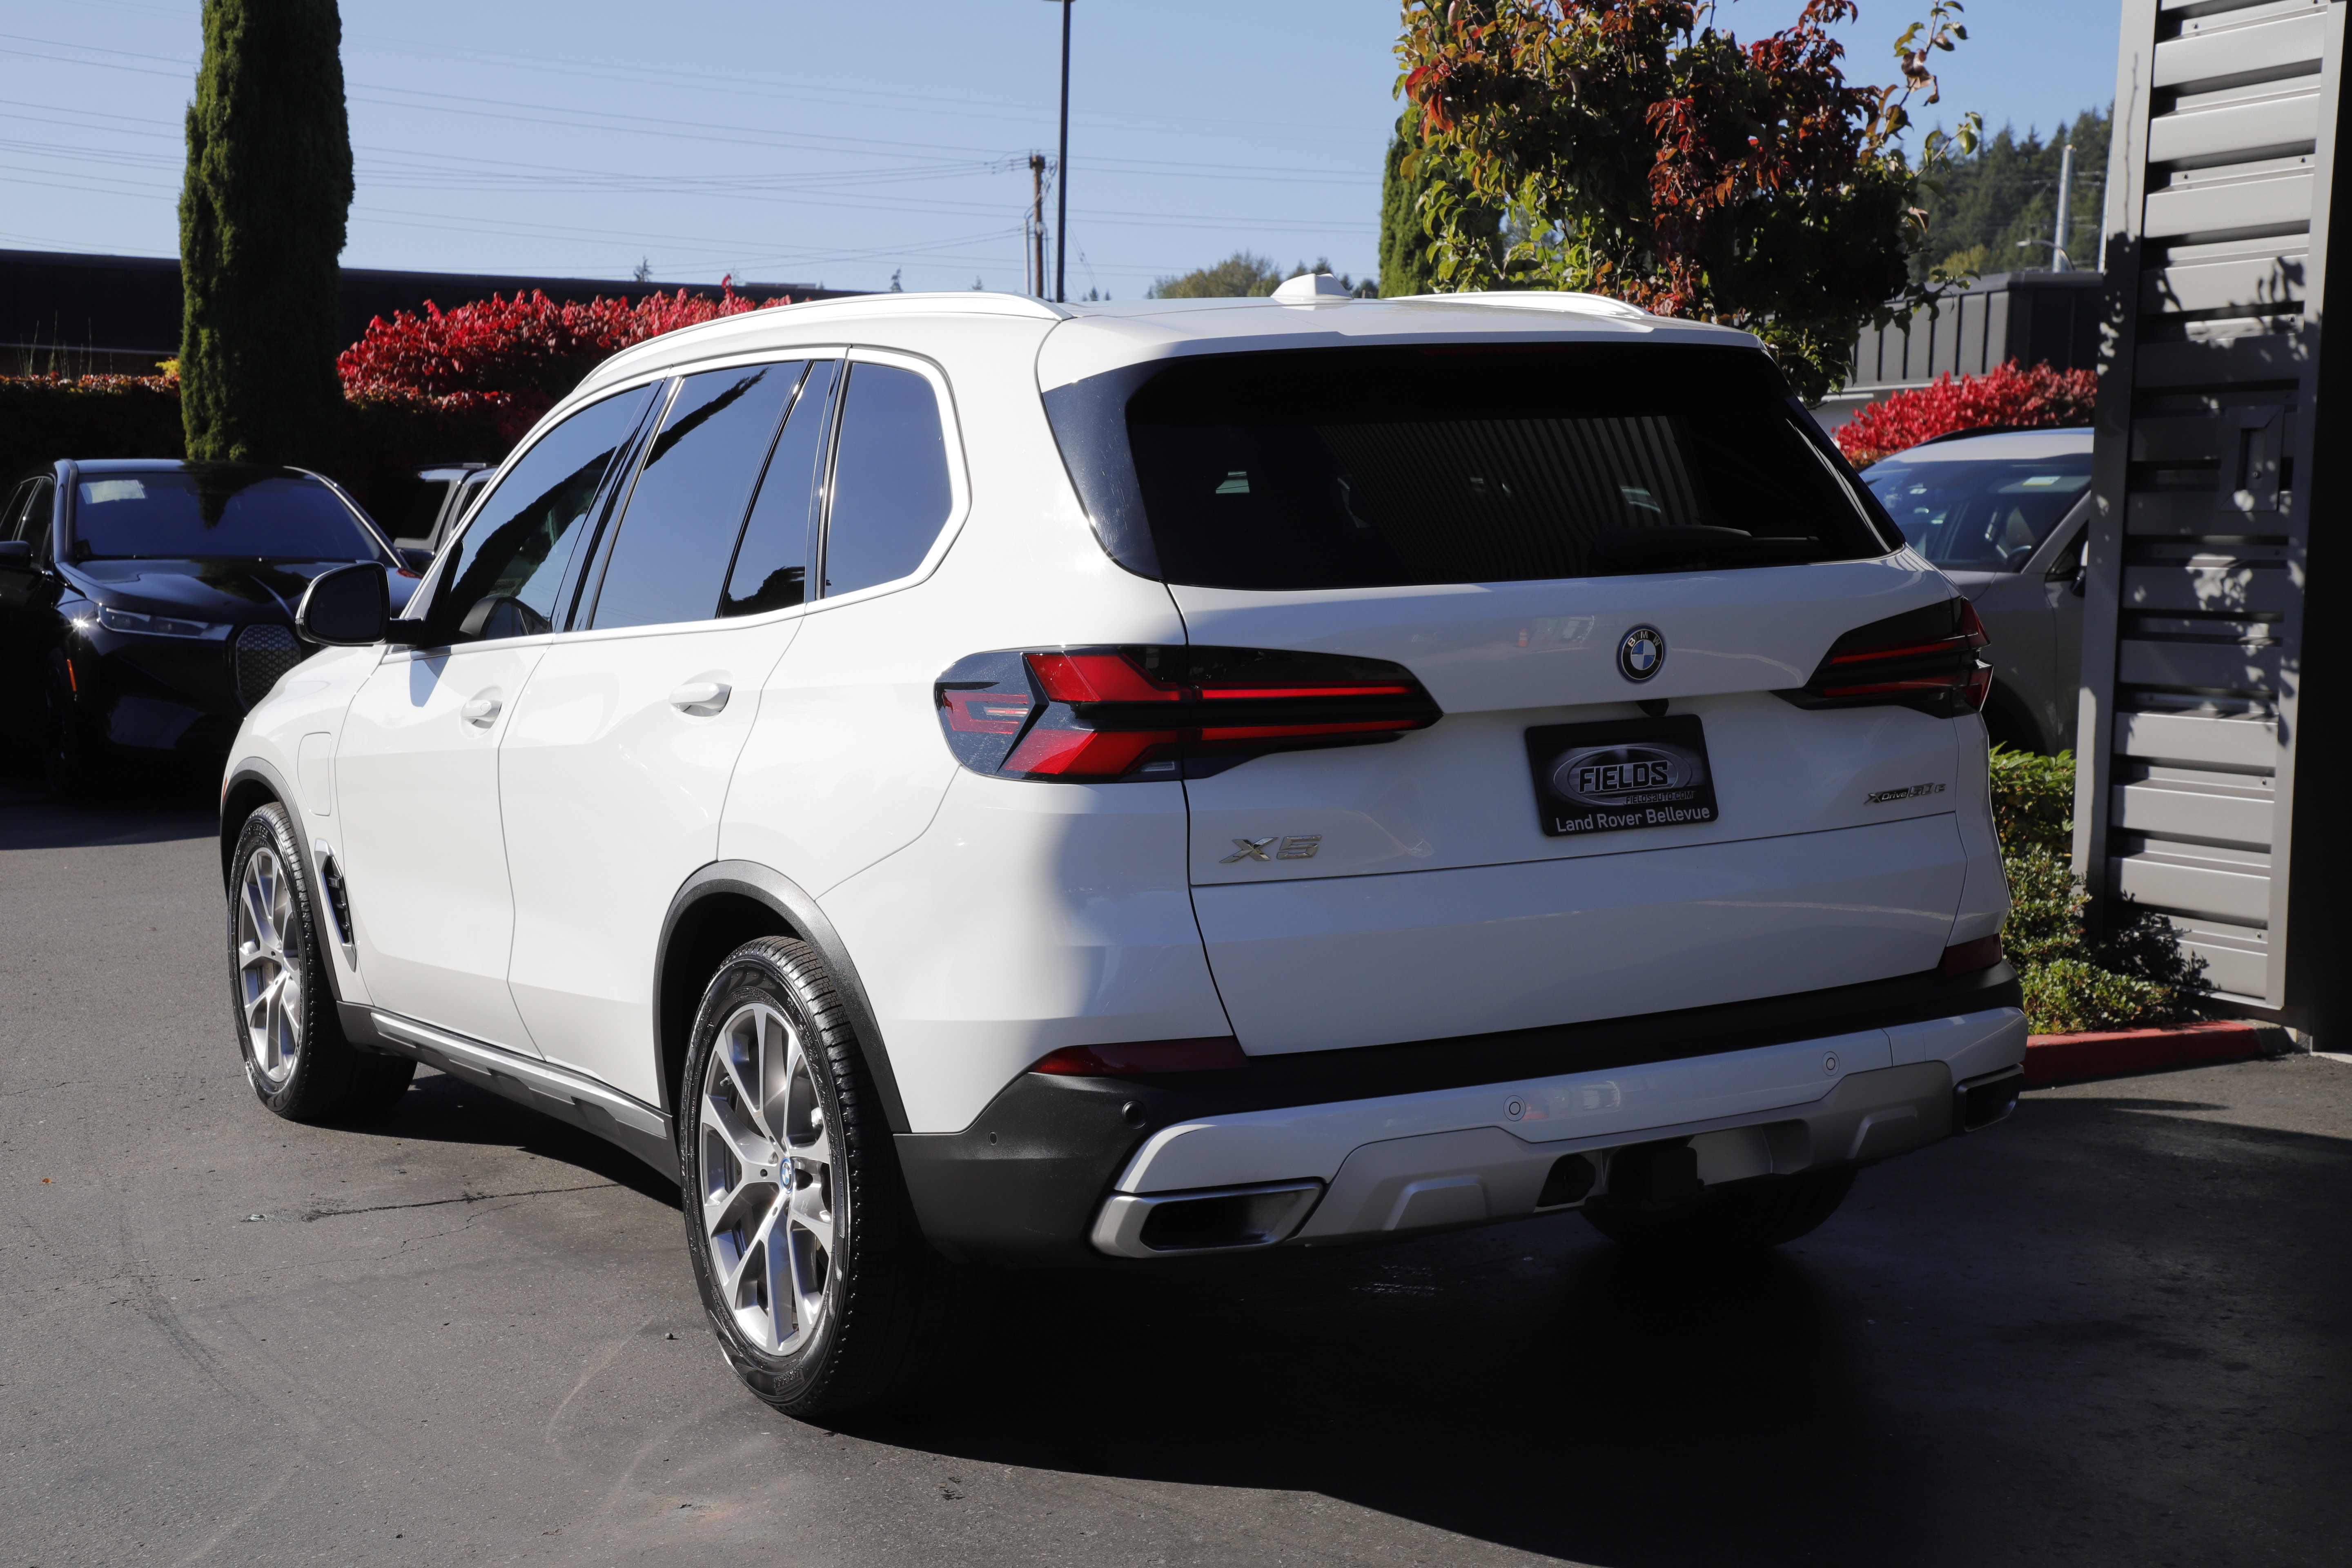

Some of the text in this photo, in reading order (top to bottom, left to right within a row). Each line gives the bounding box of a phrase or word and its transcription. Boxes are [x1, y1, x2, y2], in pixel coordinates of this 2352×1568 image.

[1627, 631, 1661, 647] BMW
[1579, 761, 1668, 793] FIELDS
[1556, 806, 1710, 832] Land Rover Bellevue
[1219, 835, 1322, 863] X5
